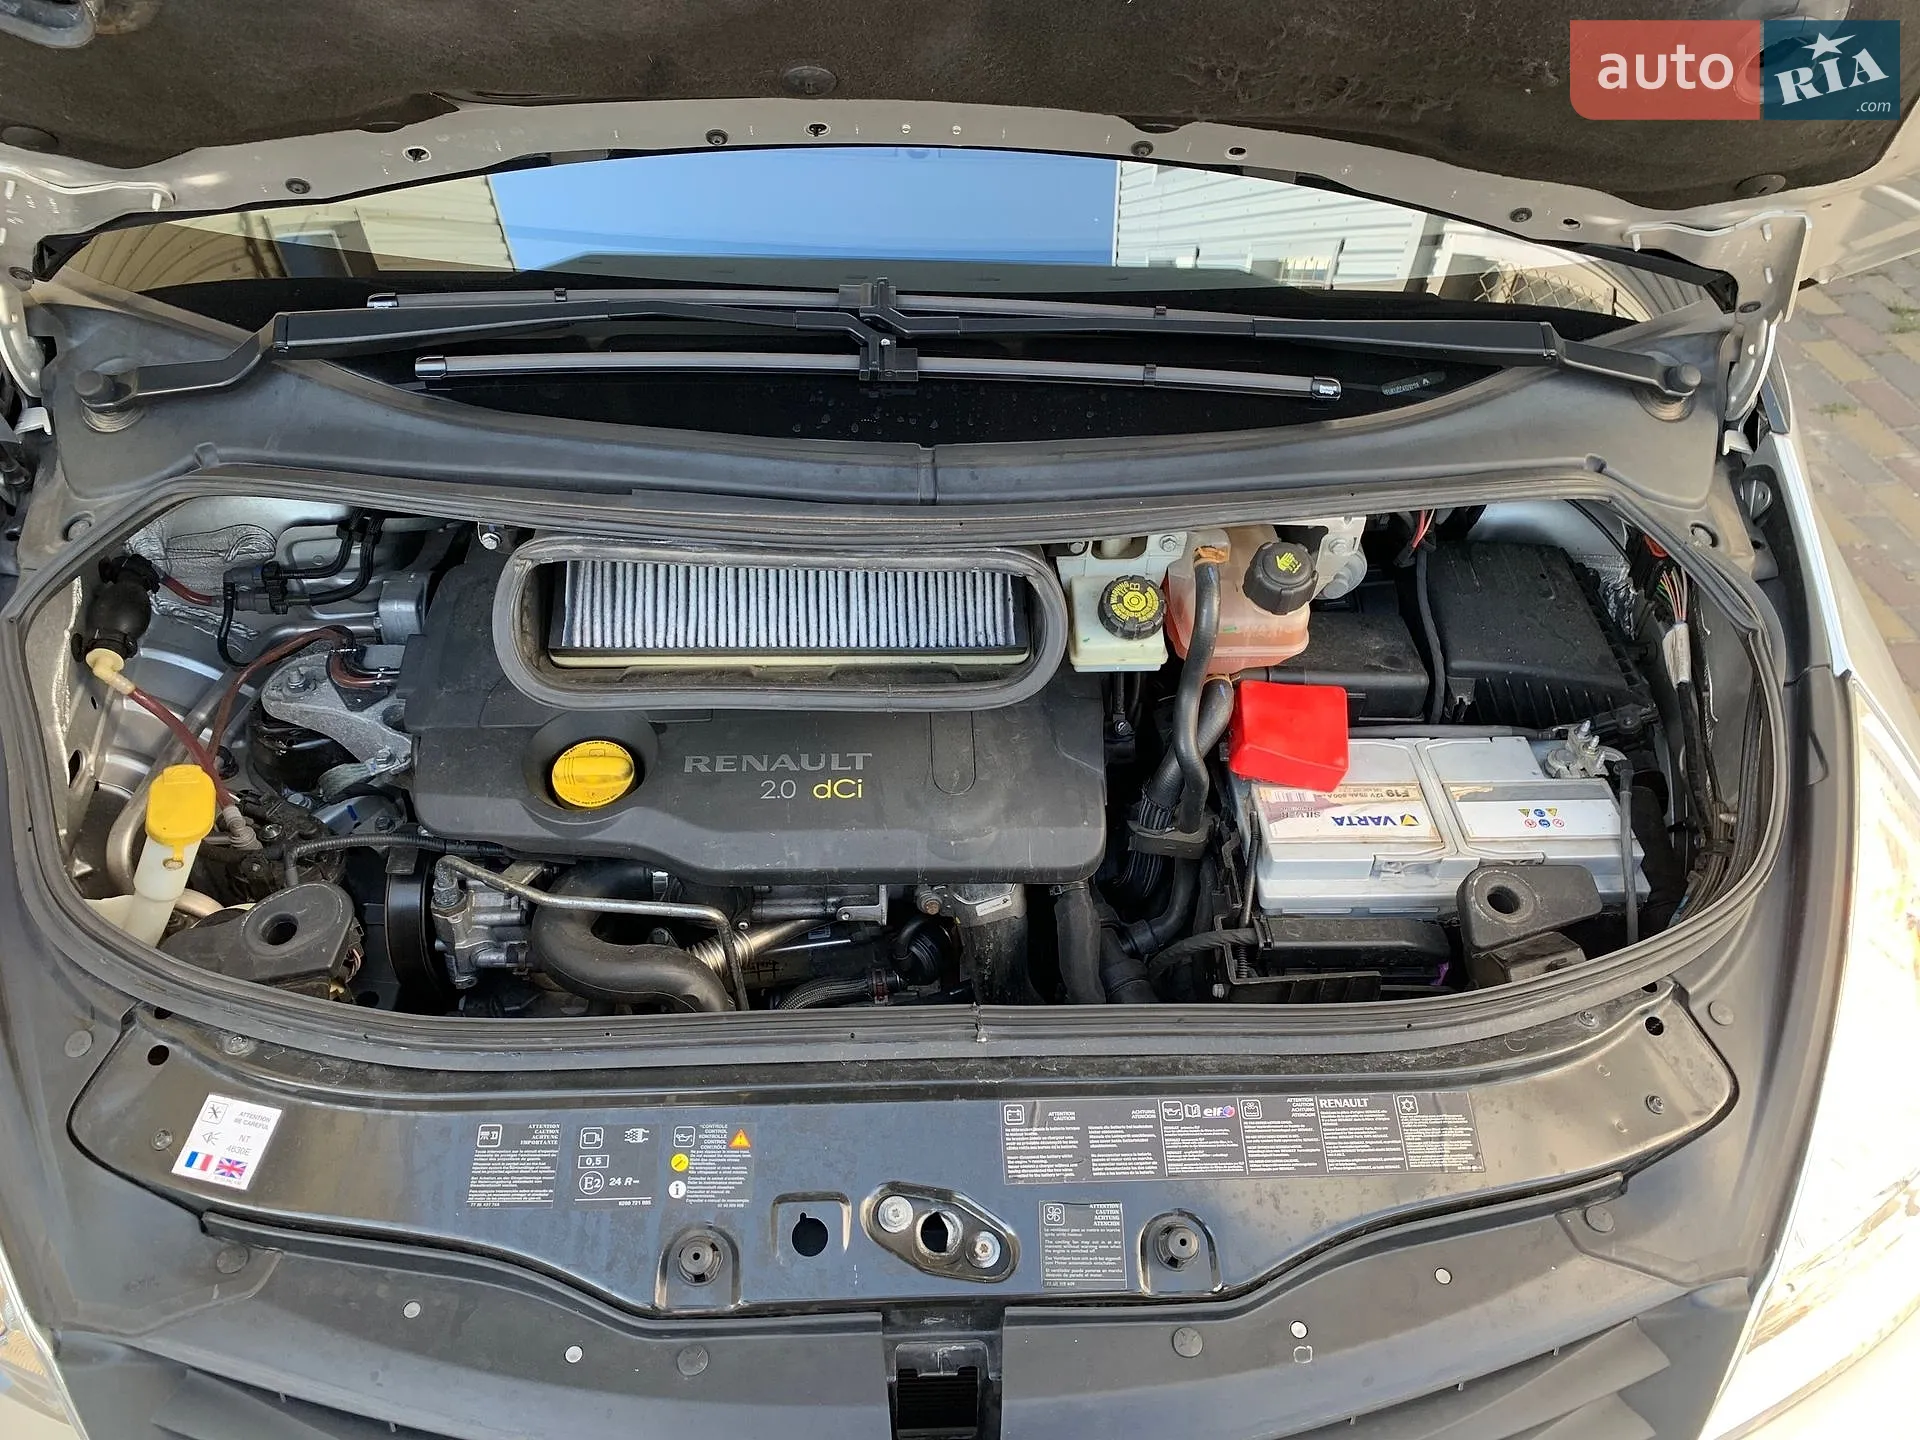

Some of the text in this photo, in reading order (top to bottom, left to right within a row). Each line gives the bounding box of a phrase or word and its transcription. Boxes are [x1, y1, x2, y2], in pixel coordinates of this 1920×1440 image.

[683, 752, 873, 773] RENAULT
[759, 778, 863, 800] 2.0 dCi
[1331, 815, 1398, 826] VARTA
[1319, 1098, 1369, 1108] RENAULT
[1203, 1107, 1224, 1116] elf
[585, 1157, 602, 1167] 0,5
[583, 1176, 601, 1190] E2
[608, 1177, 622, 1186] 24
